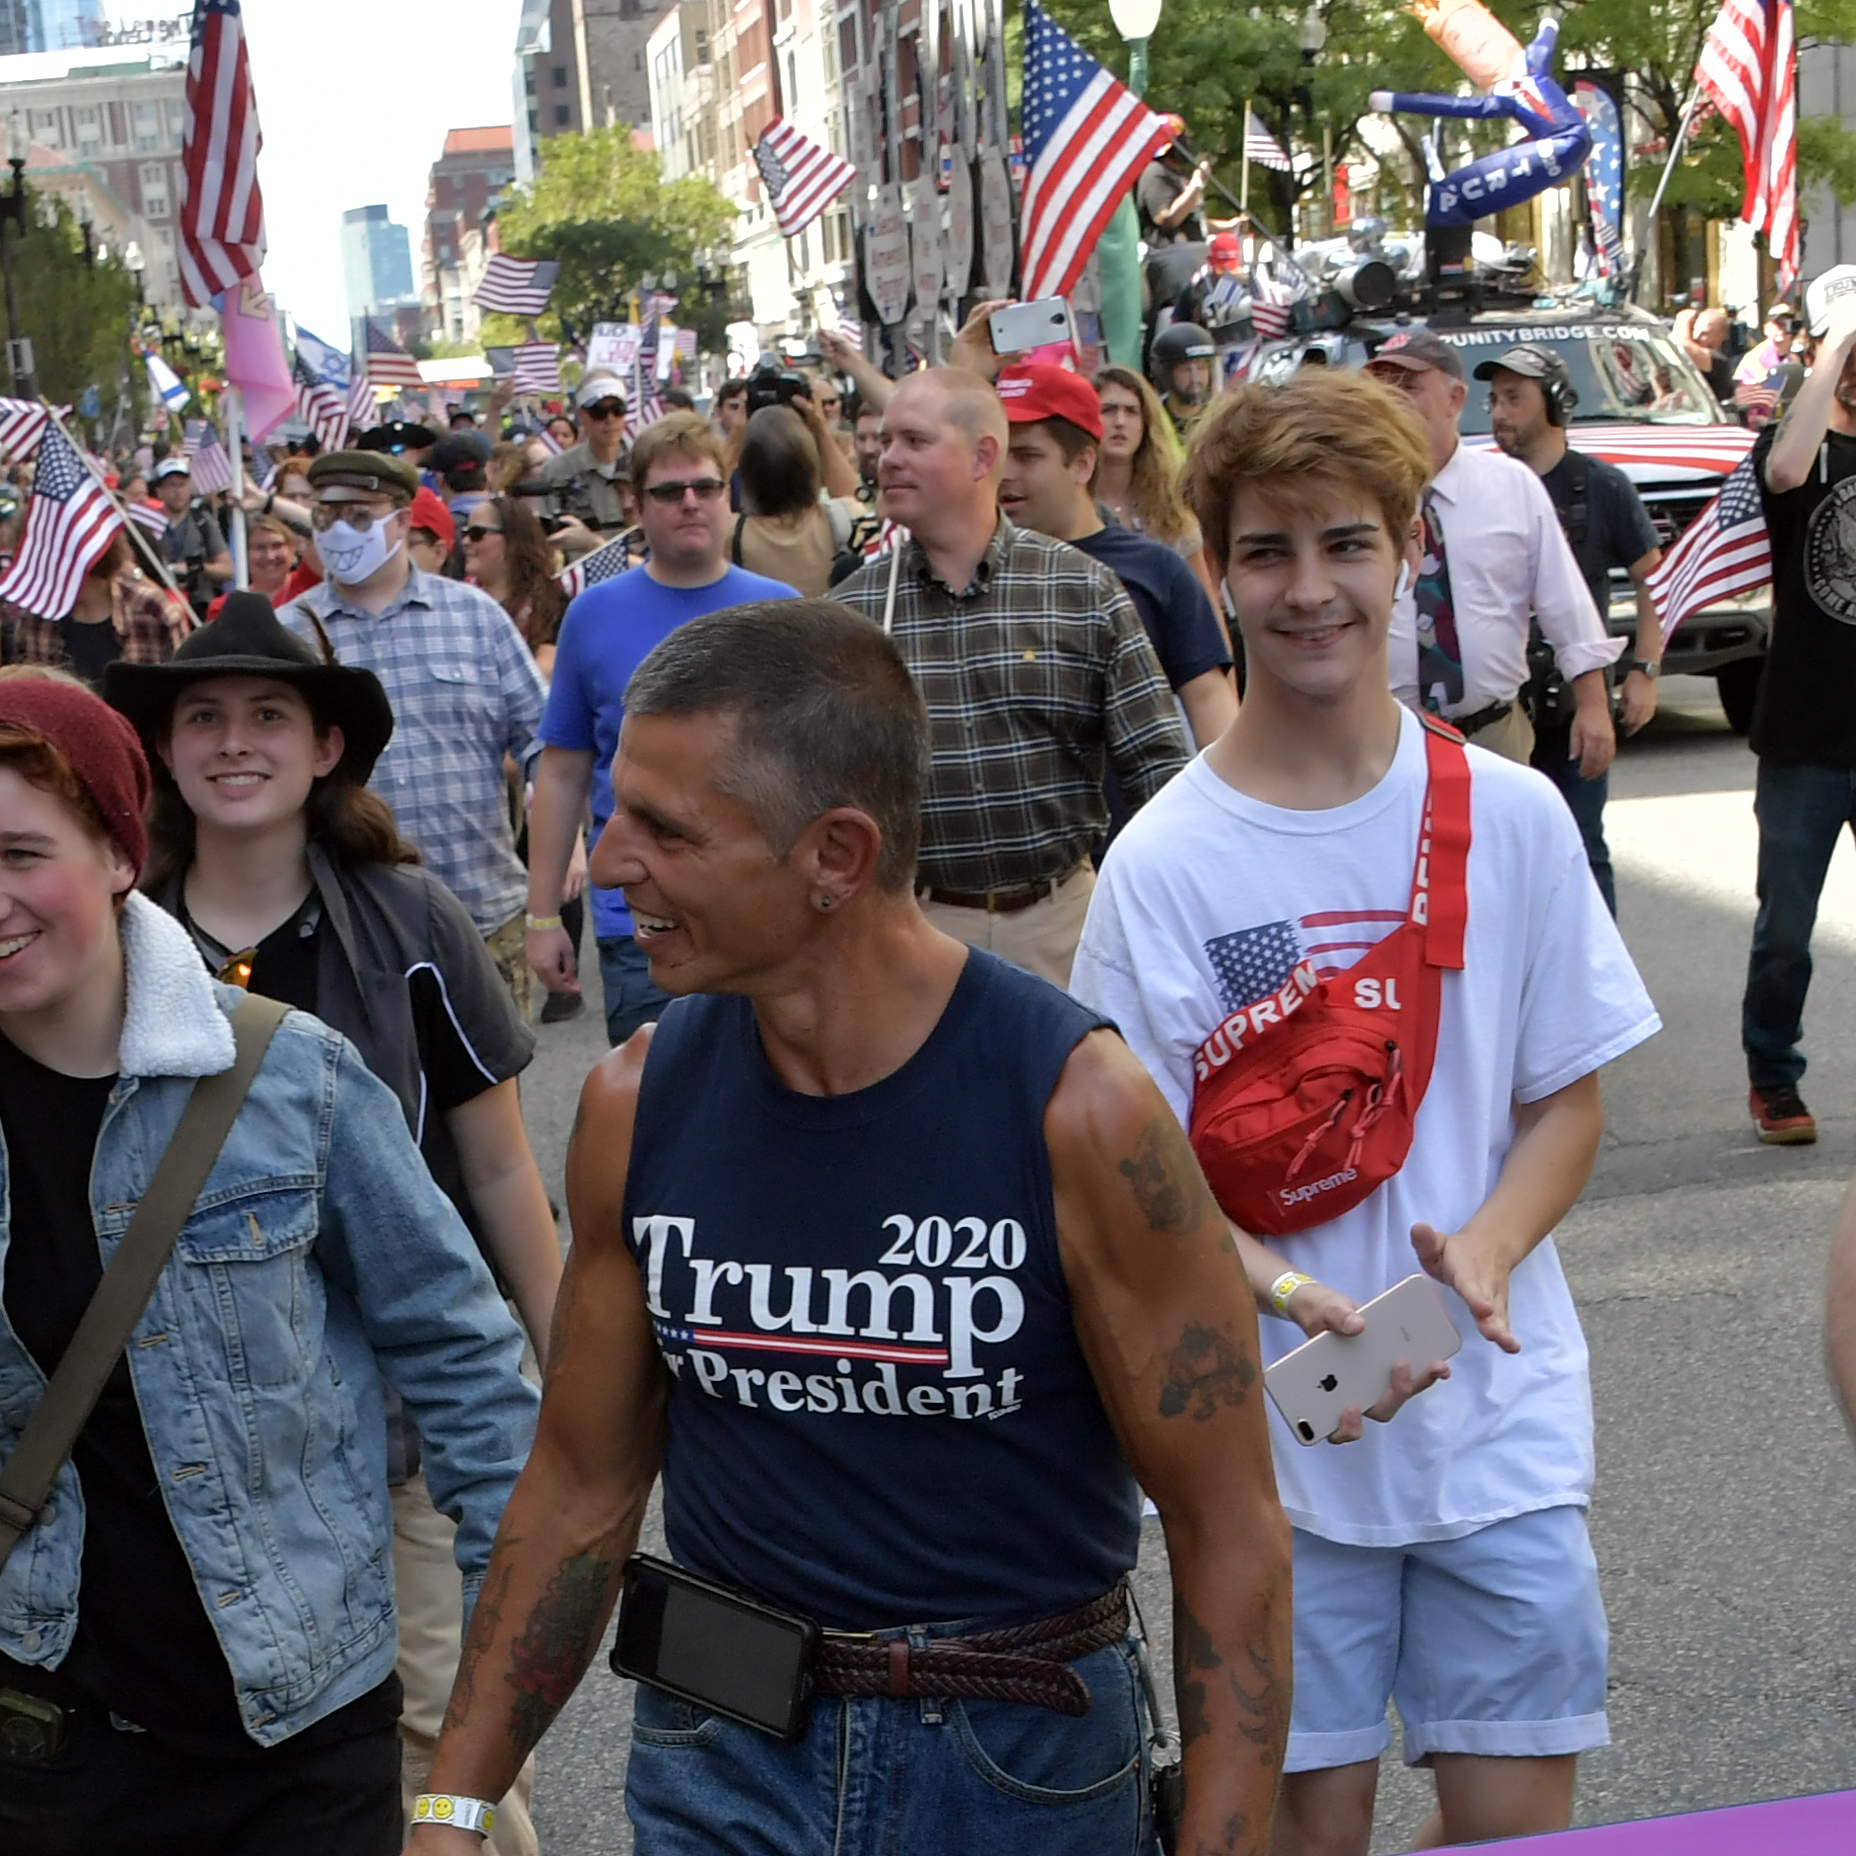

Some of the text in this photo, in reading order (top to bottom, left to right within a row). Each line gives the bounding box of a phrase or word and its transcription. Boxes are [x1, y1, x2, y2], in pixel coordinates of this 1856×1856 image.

[1438, 157, 1533, 213] TRUP
[1278, 1166, 1358, 1207] Supreme
[878, 1213, 1028, 1271] 2020
[632, 1213, 1027, 1379] Trump
[685, 1348, 1026, 1421] President
